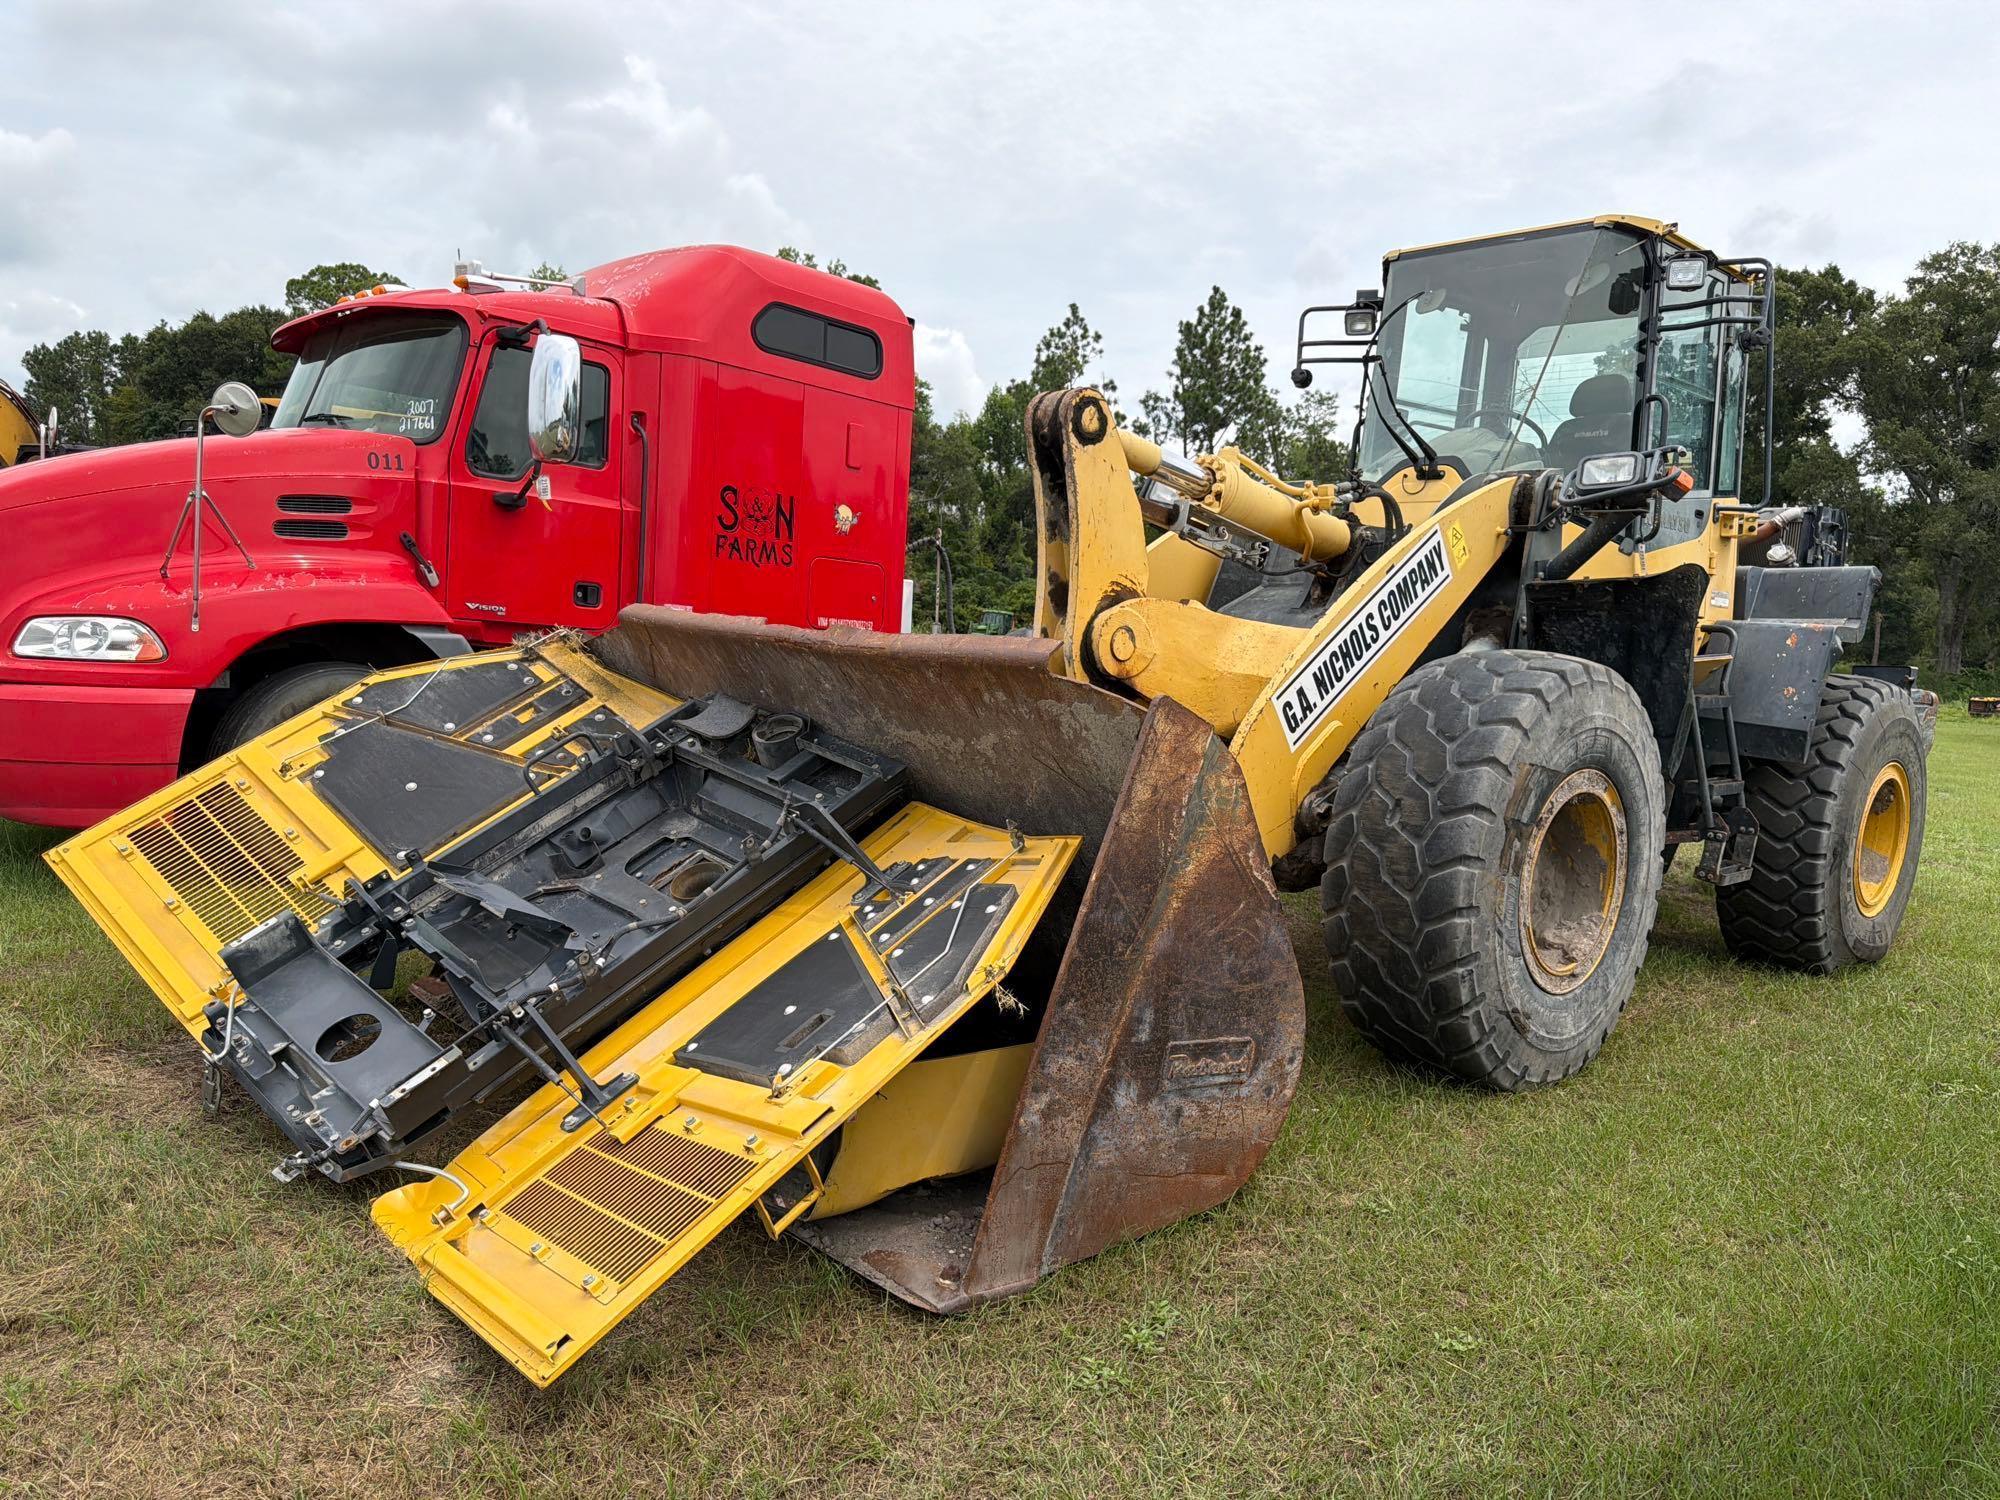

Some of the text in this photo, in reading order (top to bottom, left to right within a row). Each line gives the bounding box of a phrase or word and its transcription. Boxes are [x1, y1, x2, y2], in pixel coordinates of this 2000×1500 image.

[399, 416, 435, 432] 217661
[367, 452, 404, 471] 011
[715, 534, 793, 567] FARMS
[1282, 540, 1445, 734] G.A. NICHOLS COMPANY
